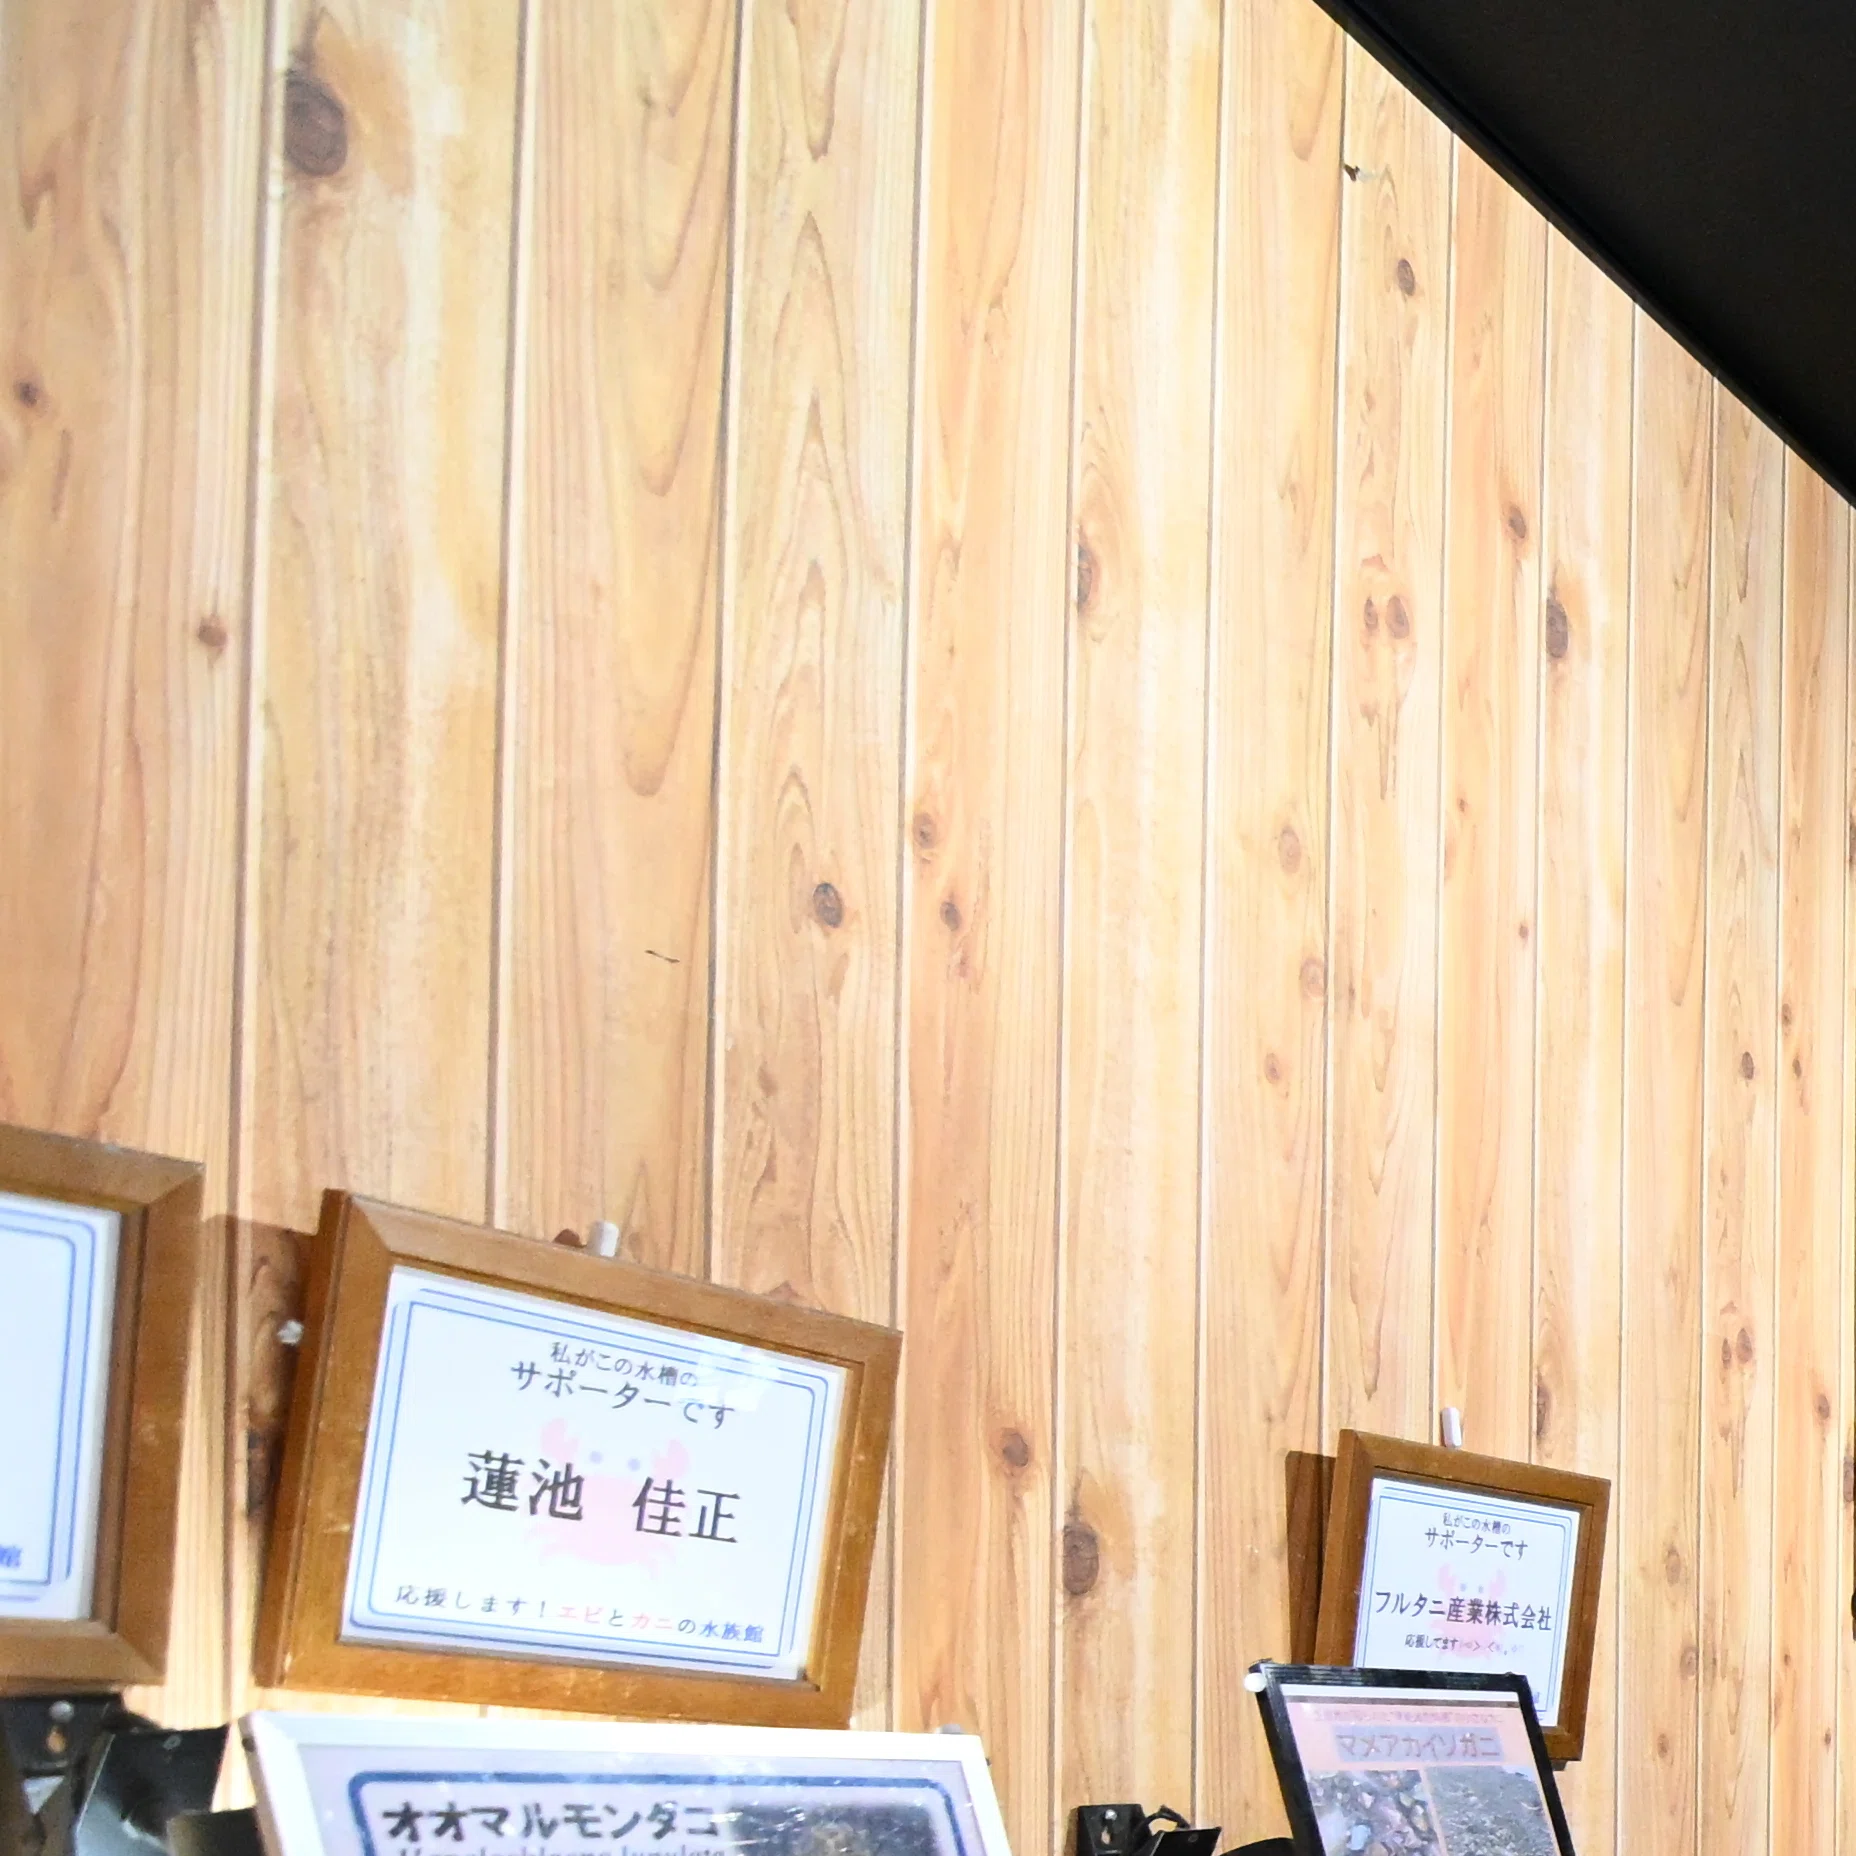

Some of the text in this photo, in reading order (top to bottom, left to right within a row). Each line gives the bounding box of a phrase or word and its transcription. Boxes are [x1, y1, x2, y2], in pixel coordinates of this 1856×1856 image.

[550, 1341, 699, 1389] 私がこの水槽の
[510, 1360, 737, 1431] サポーターです
[460, 1449, 741, 1545] 蓮池 佳正
[1425, 1527, 1528, 1560] サポーターです
[1375, 1590, 1553, 1631] フルタニ産業株式会社
[1336, 1732, 1500, 1760] マメアカイソガニ
[382, 1800, 719, 1843] オオマルモンダコ
